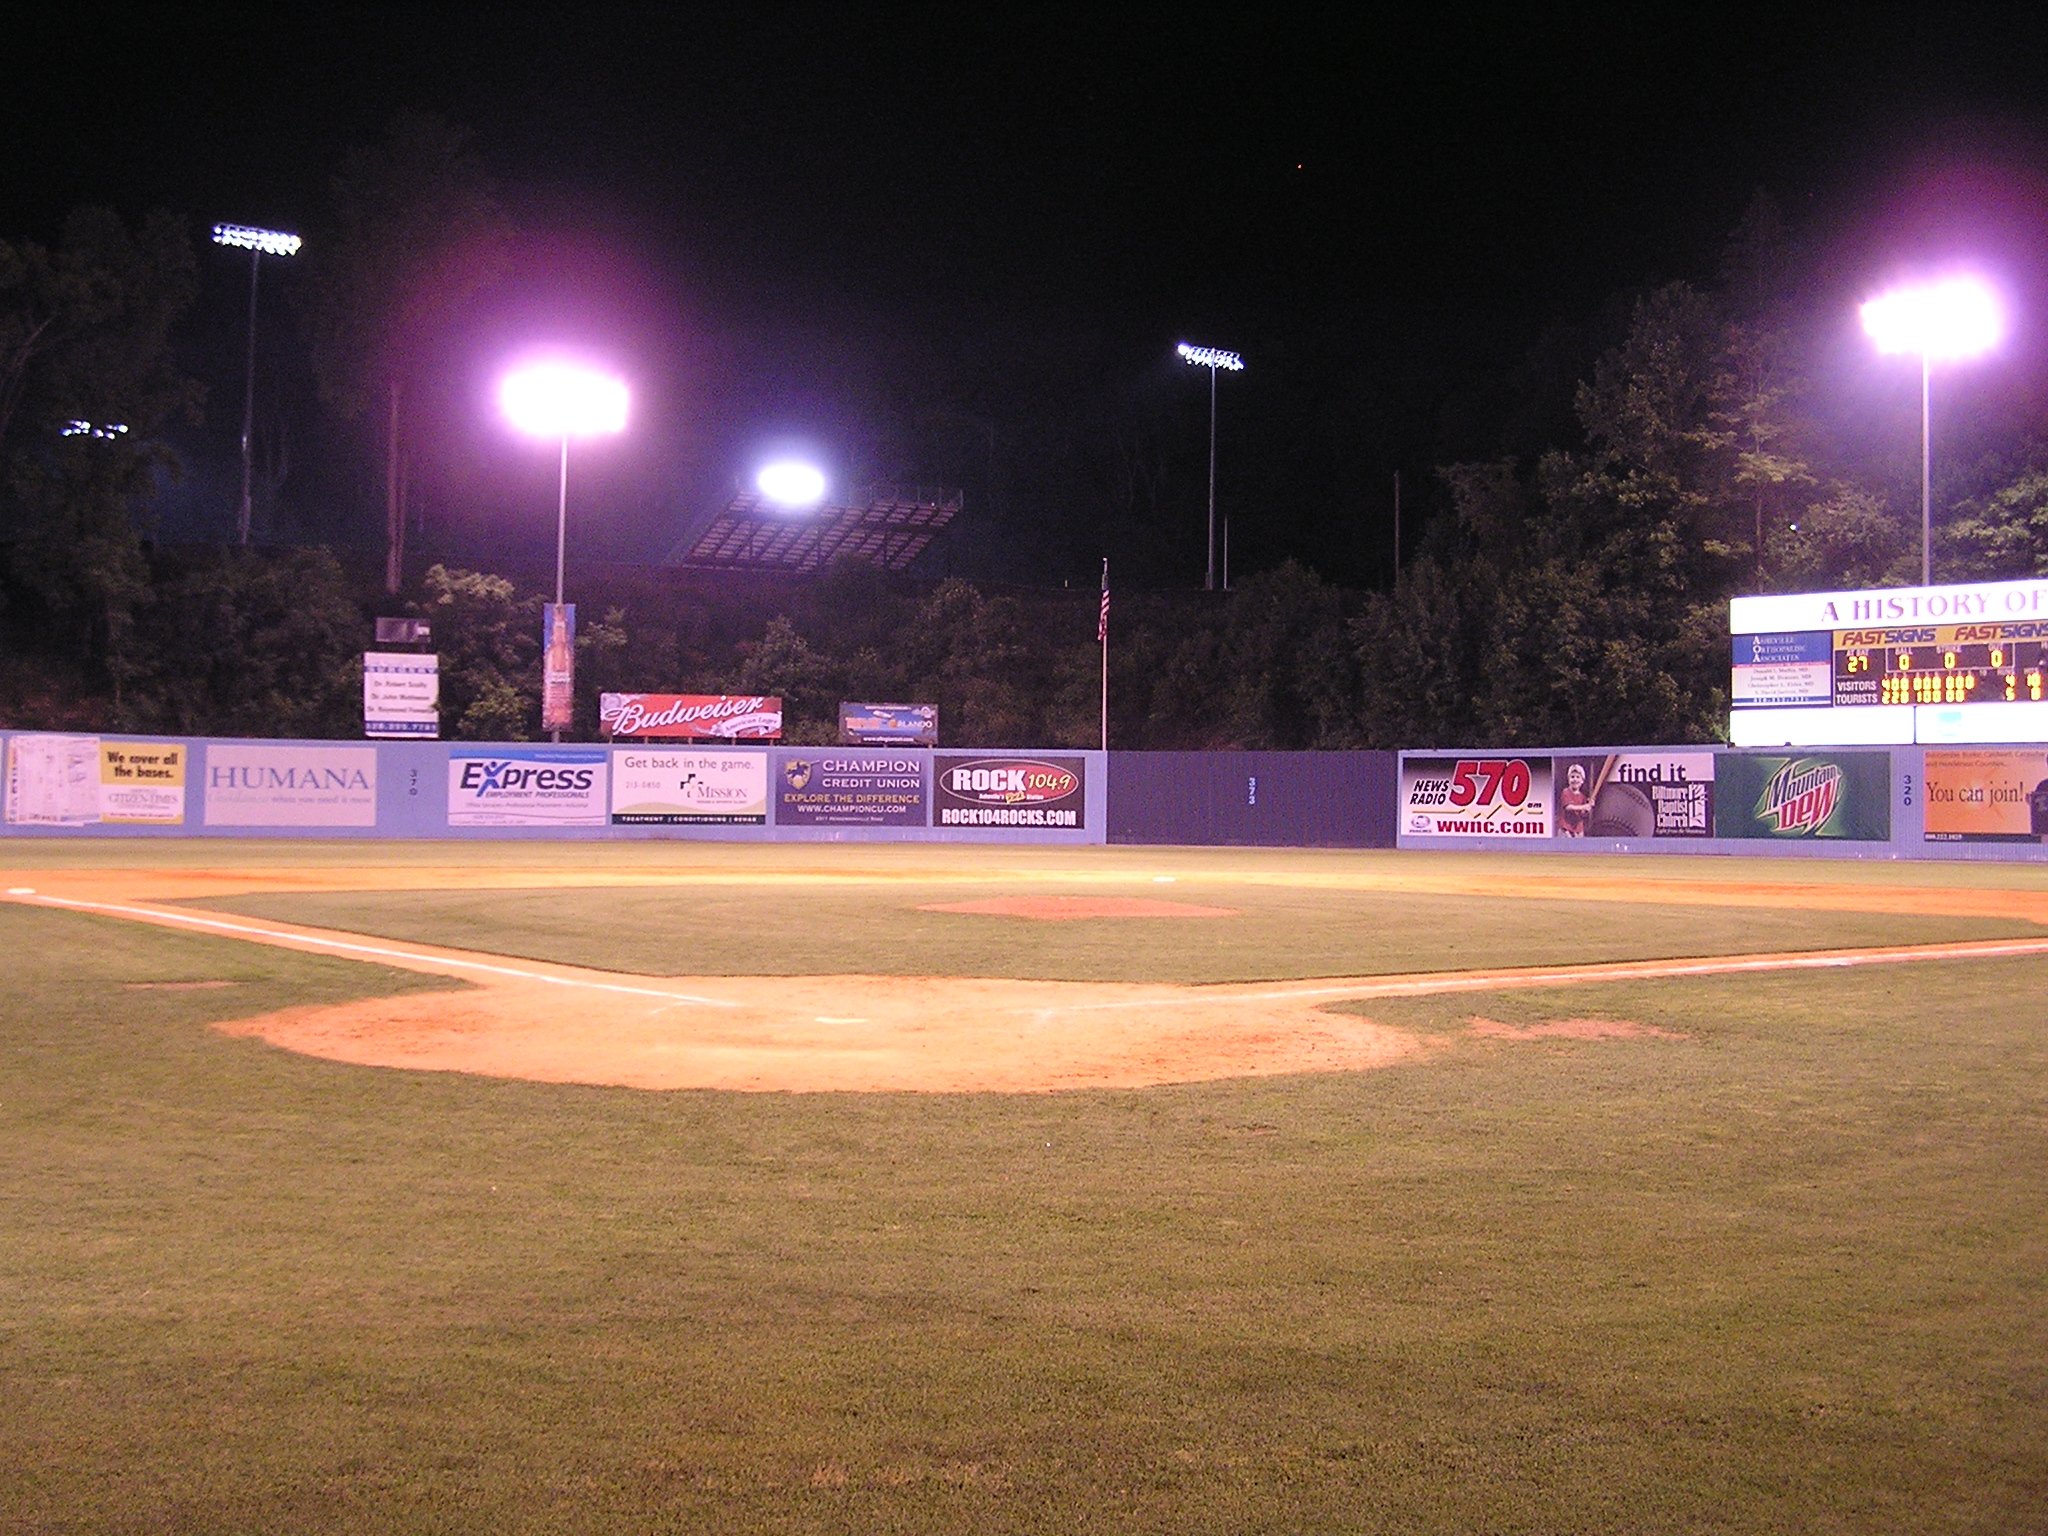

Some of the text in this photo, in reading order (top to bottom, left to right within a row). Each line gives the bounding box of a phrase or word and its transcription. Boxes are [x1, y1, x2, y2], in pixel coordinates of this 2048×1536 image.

[1821, 589, 2047, 622] A HISTORY OF
[1842, 628, 1937, 646] FASTSIGNS
[1847, 650, 2003, 673] 27 0 0 0
[1837, 681, 1877, 692] VISITORS
[1836, 693, 1878, 704] TOURISTS
[602, 696, 764, 735] Budweiser
[107, 752, 178, 765] We cover all
[625, 757, 755, 772] Get back in the game.
[823, 759, 920, 772] CHAMPION
[114, 766, 175, 779] the bases.
[210, 766, 370, 790] HUMANA
[952, 769, 1071, 791] ROCK 104.9
[1618, 763, 1687, 782] find it
[823, 778, 920, 789] CREDIT UNION
[1413, 780, 1449, 792] NEWS
[1449, 759, 1531, 807] 570
[1769, 764, 1838, 809] Mountain
[1903, 774, 1912, 807] 320
[697, 786, 748, 799] MISSION
[784, 793, 920, 804] EXPLORE THE DIFFERENCE
[1409, 793, 1446, 805] RADIO
[1926, 780, 2024, 808] You can join!
[797, 804, 907, 814] WWW.CHAMPIONCU.COM
[941, 809, 1076, 826] ROCK104ROCKS.COM
[1436, 820, 1544, 834] wwnc.com
